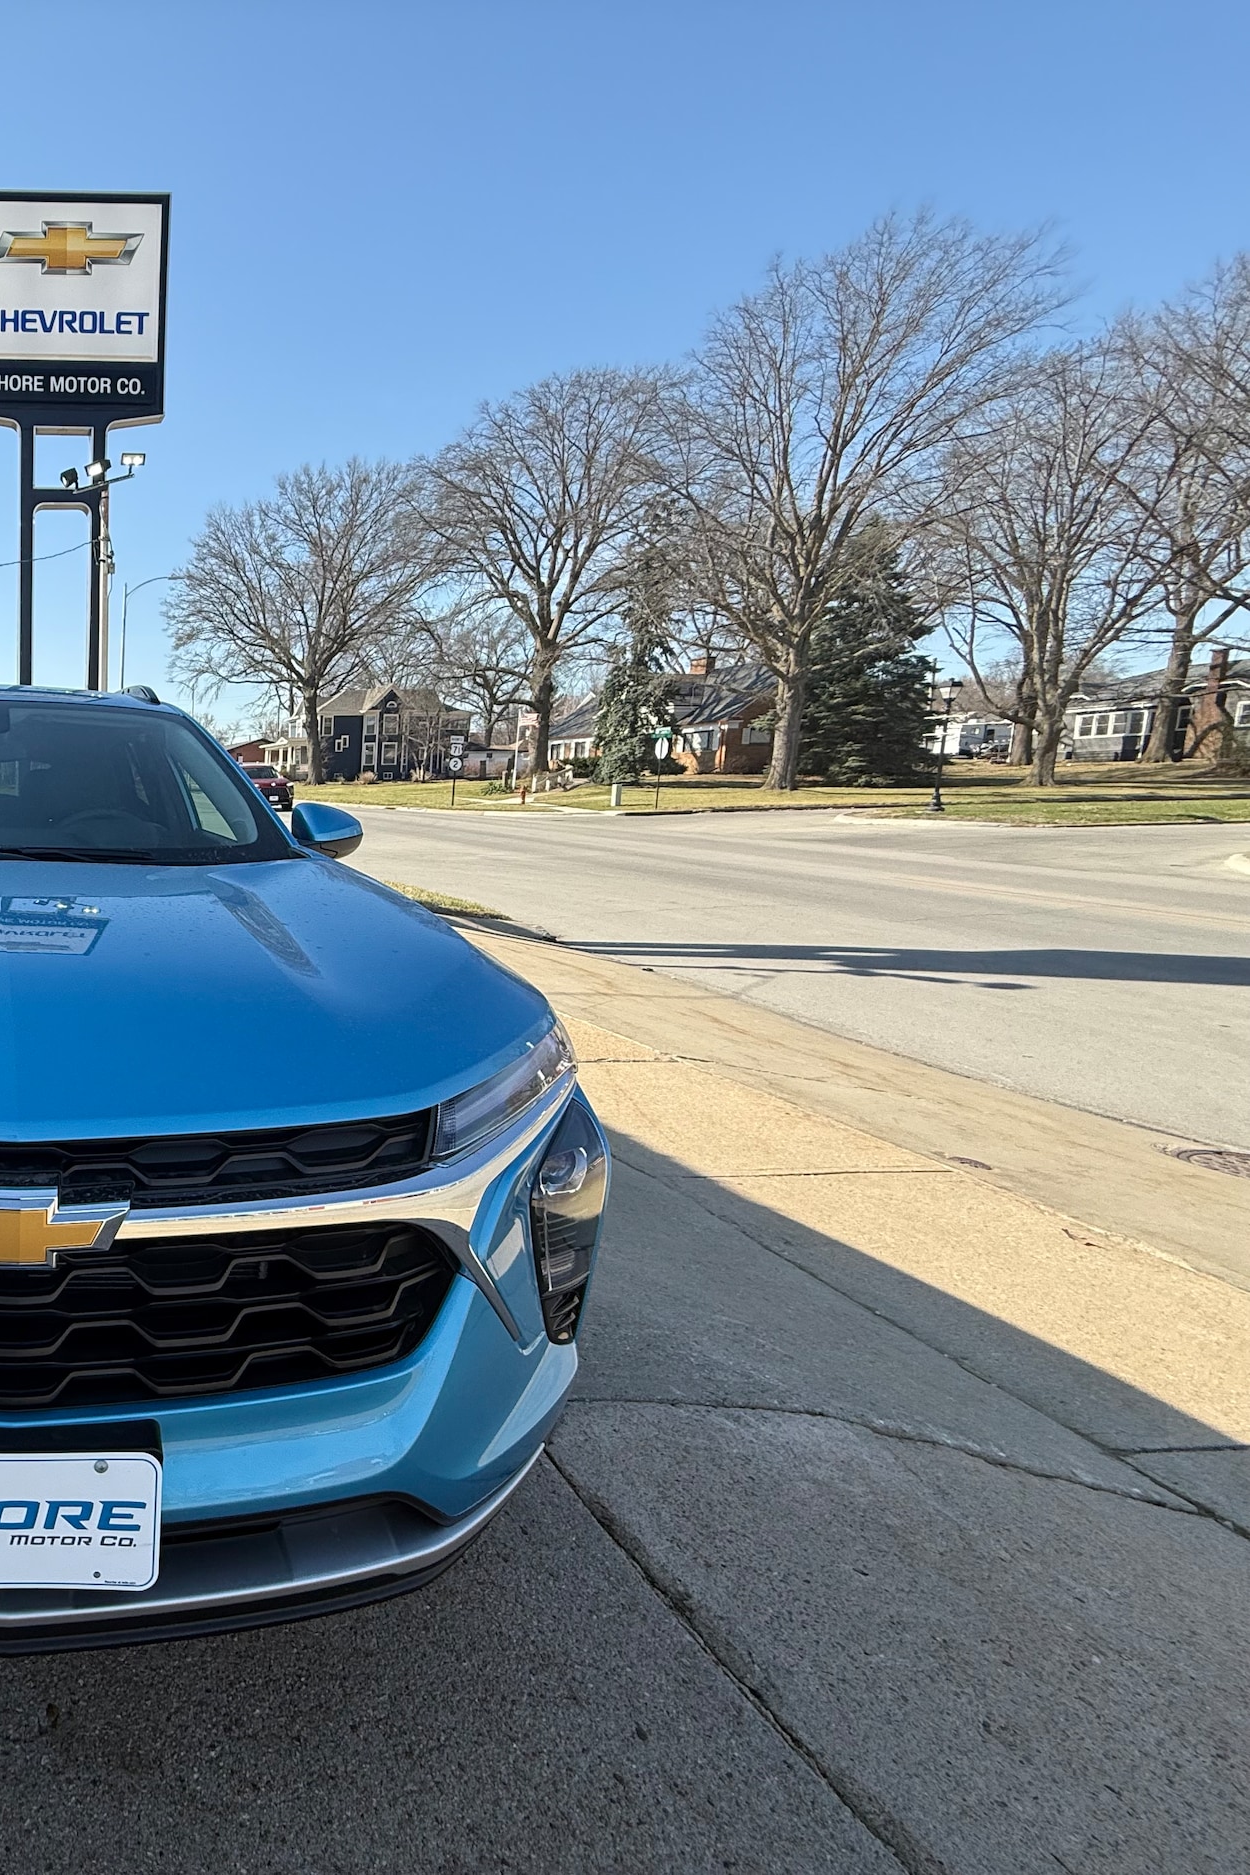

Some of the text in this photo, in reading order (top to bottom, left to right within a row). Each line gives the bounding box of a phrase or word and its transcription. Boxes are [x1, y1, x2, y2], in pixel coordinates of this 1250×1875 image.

[49, 376, 112, 394] MOTOR
[116, 377, 146, 395] CO.
[9, 1534, 137, 1548] MOTOR CO.
